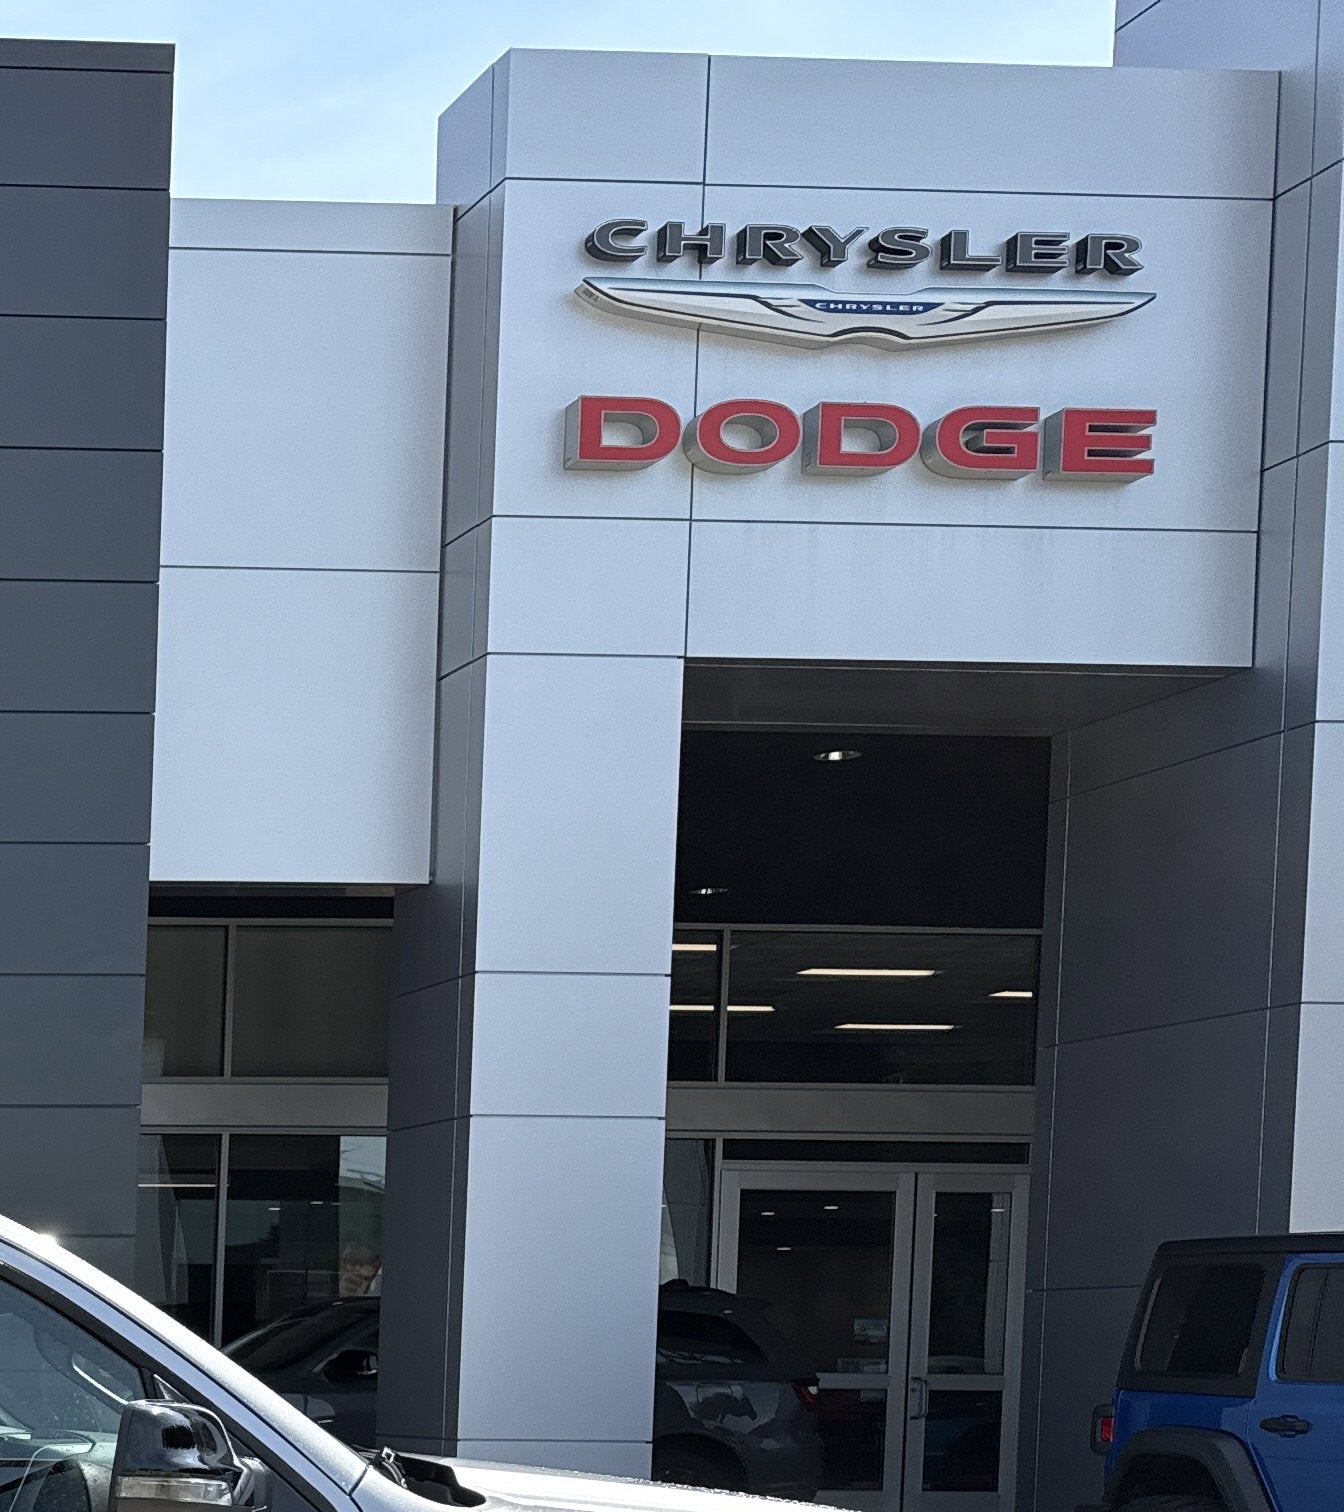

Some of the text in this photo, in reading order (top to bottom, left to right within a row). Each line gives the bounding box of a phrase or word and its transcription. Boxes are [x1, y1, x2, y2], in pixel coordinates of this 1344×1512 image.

[584, 218, 1145, 276] CHRYSLER
[815, 302, 924, 312] CHRYSLER
[564, 394, 1158, 481] DODGE
